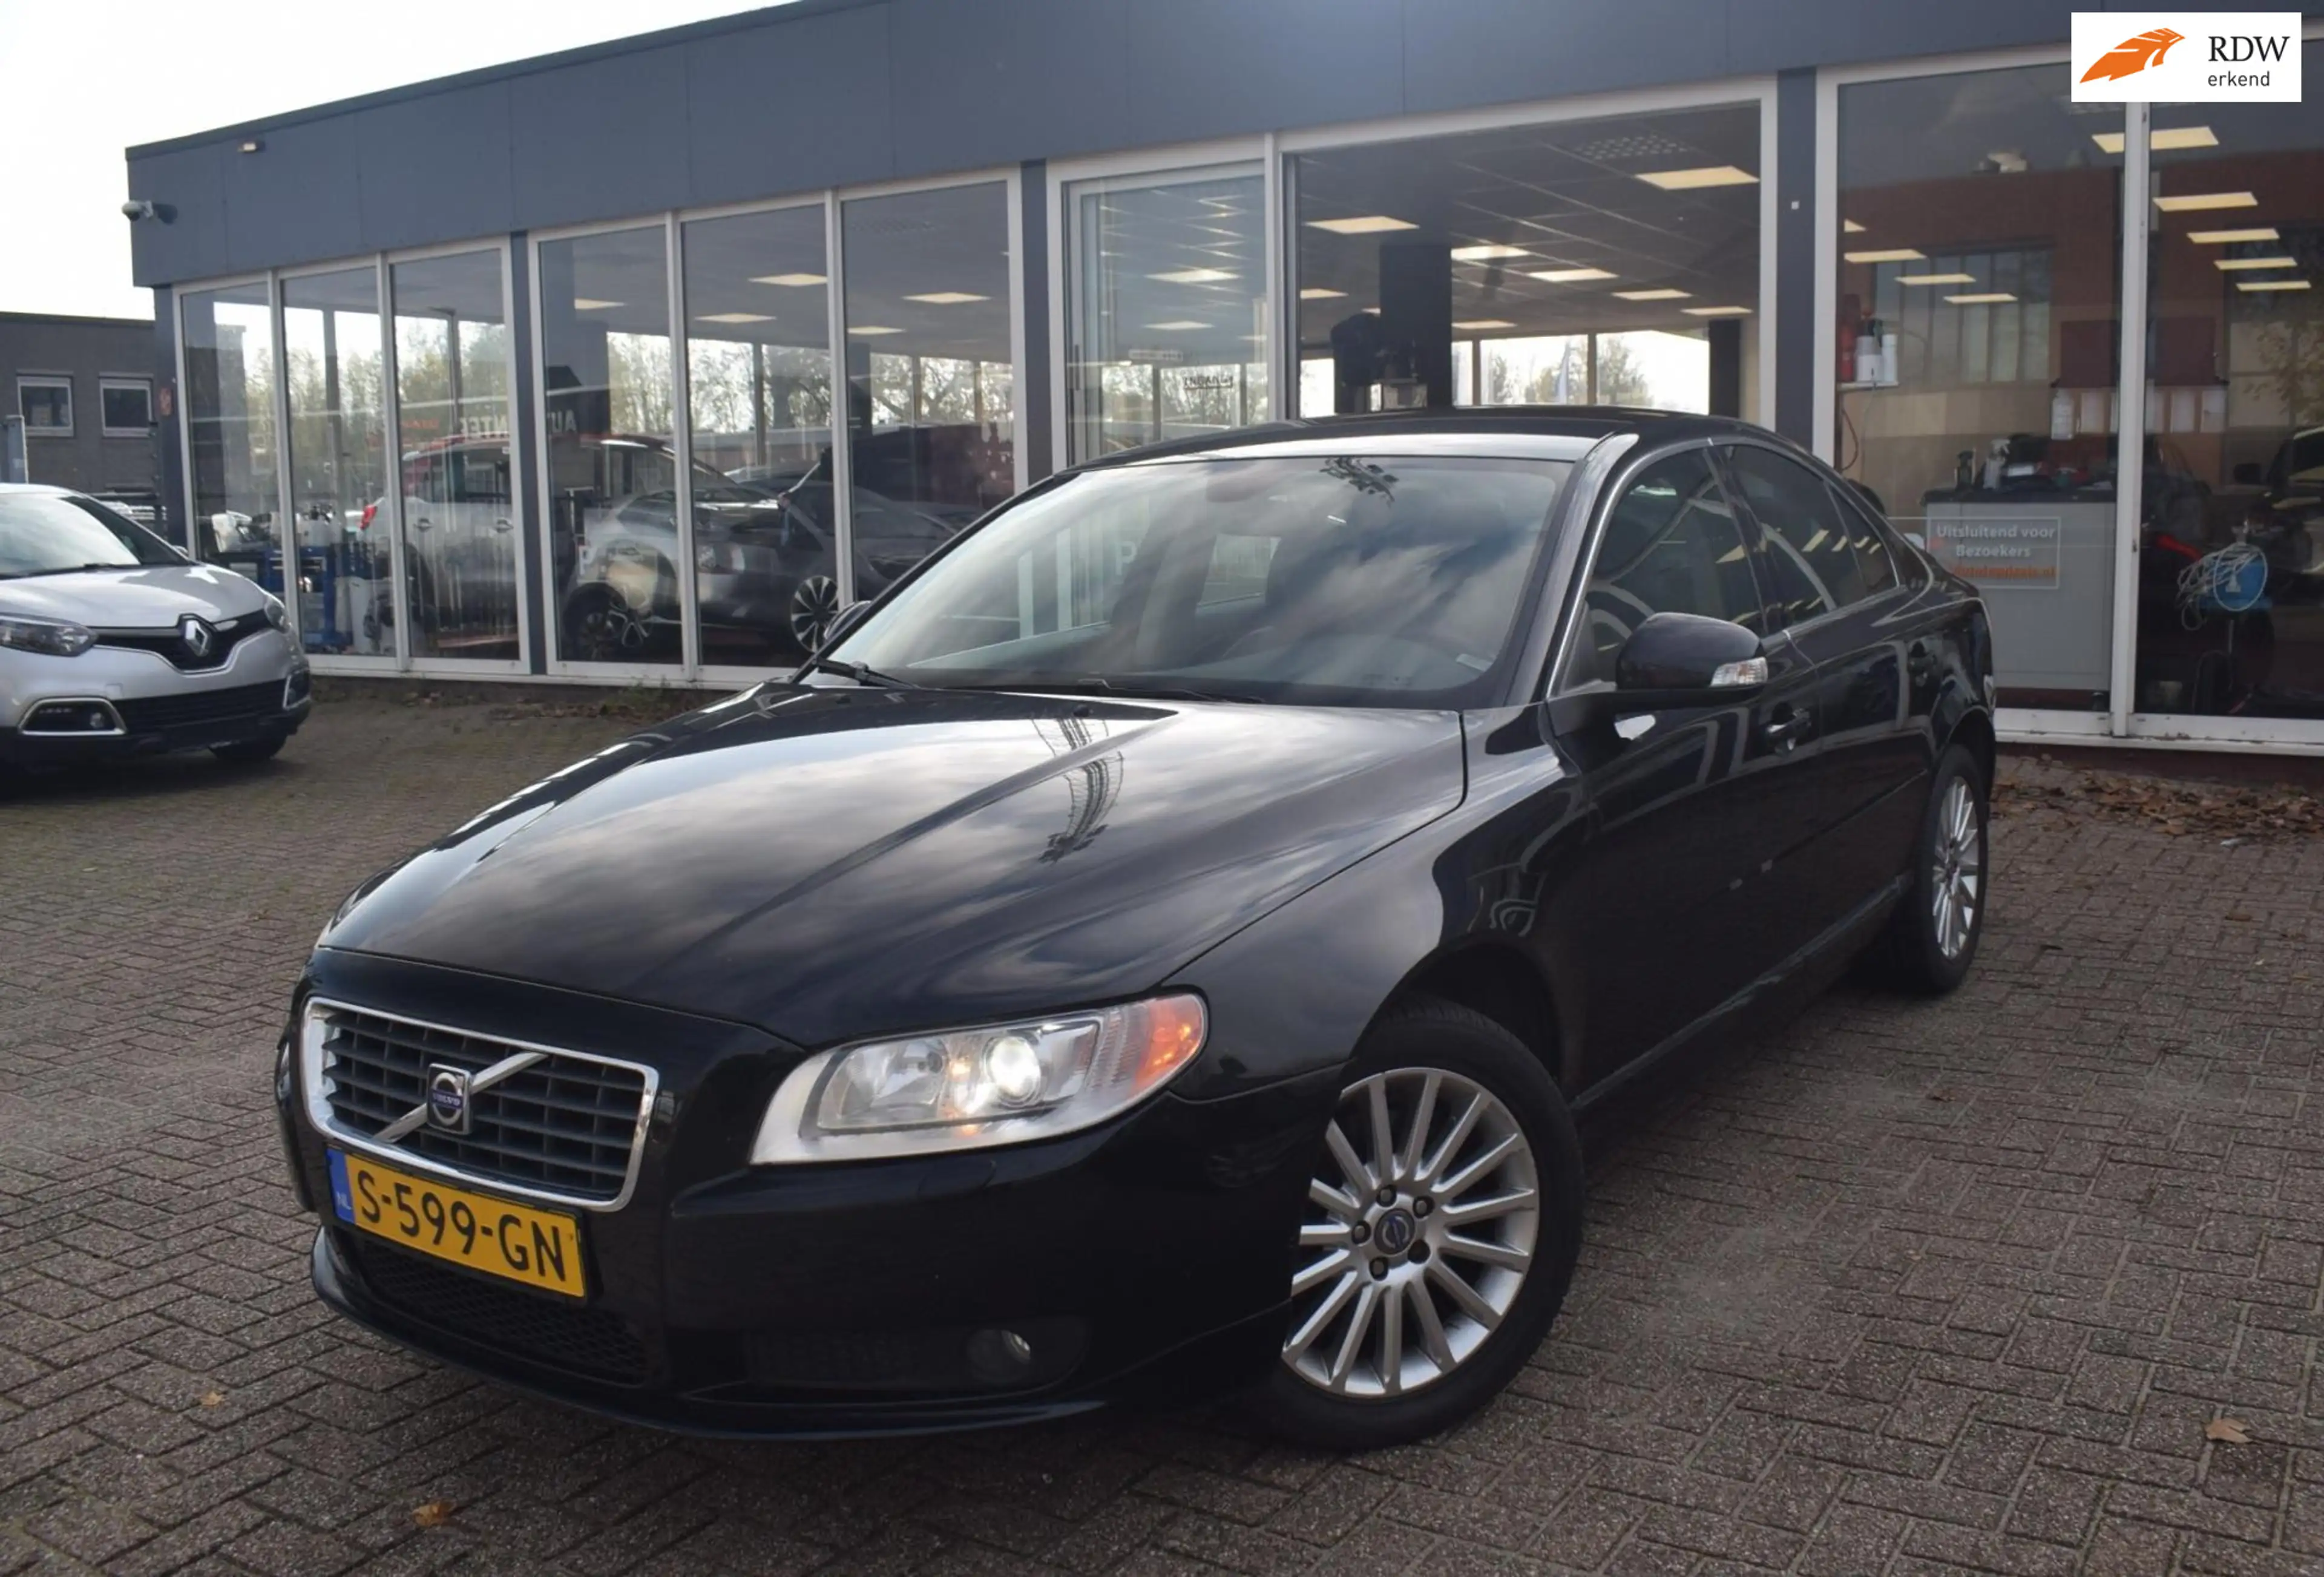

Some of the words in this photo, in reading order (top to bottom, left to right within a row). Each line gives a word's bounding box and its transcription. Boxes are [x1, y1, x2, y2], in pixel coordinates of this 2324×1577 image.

[1937, 525, 2018, 538] Uitsluitend
[2021, 528, 2056, 538] voor
[1956, 544, 2031, 557] Bezoekers
[357, 1170, 566, 1282] S-599-GN
